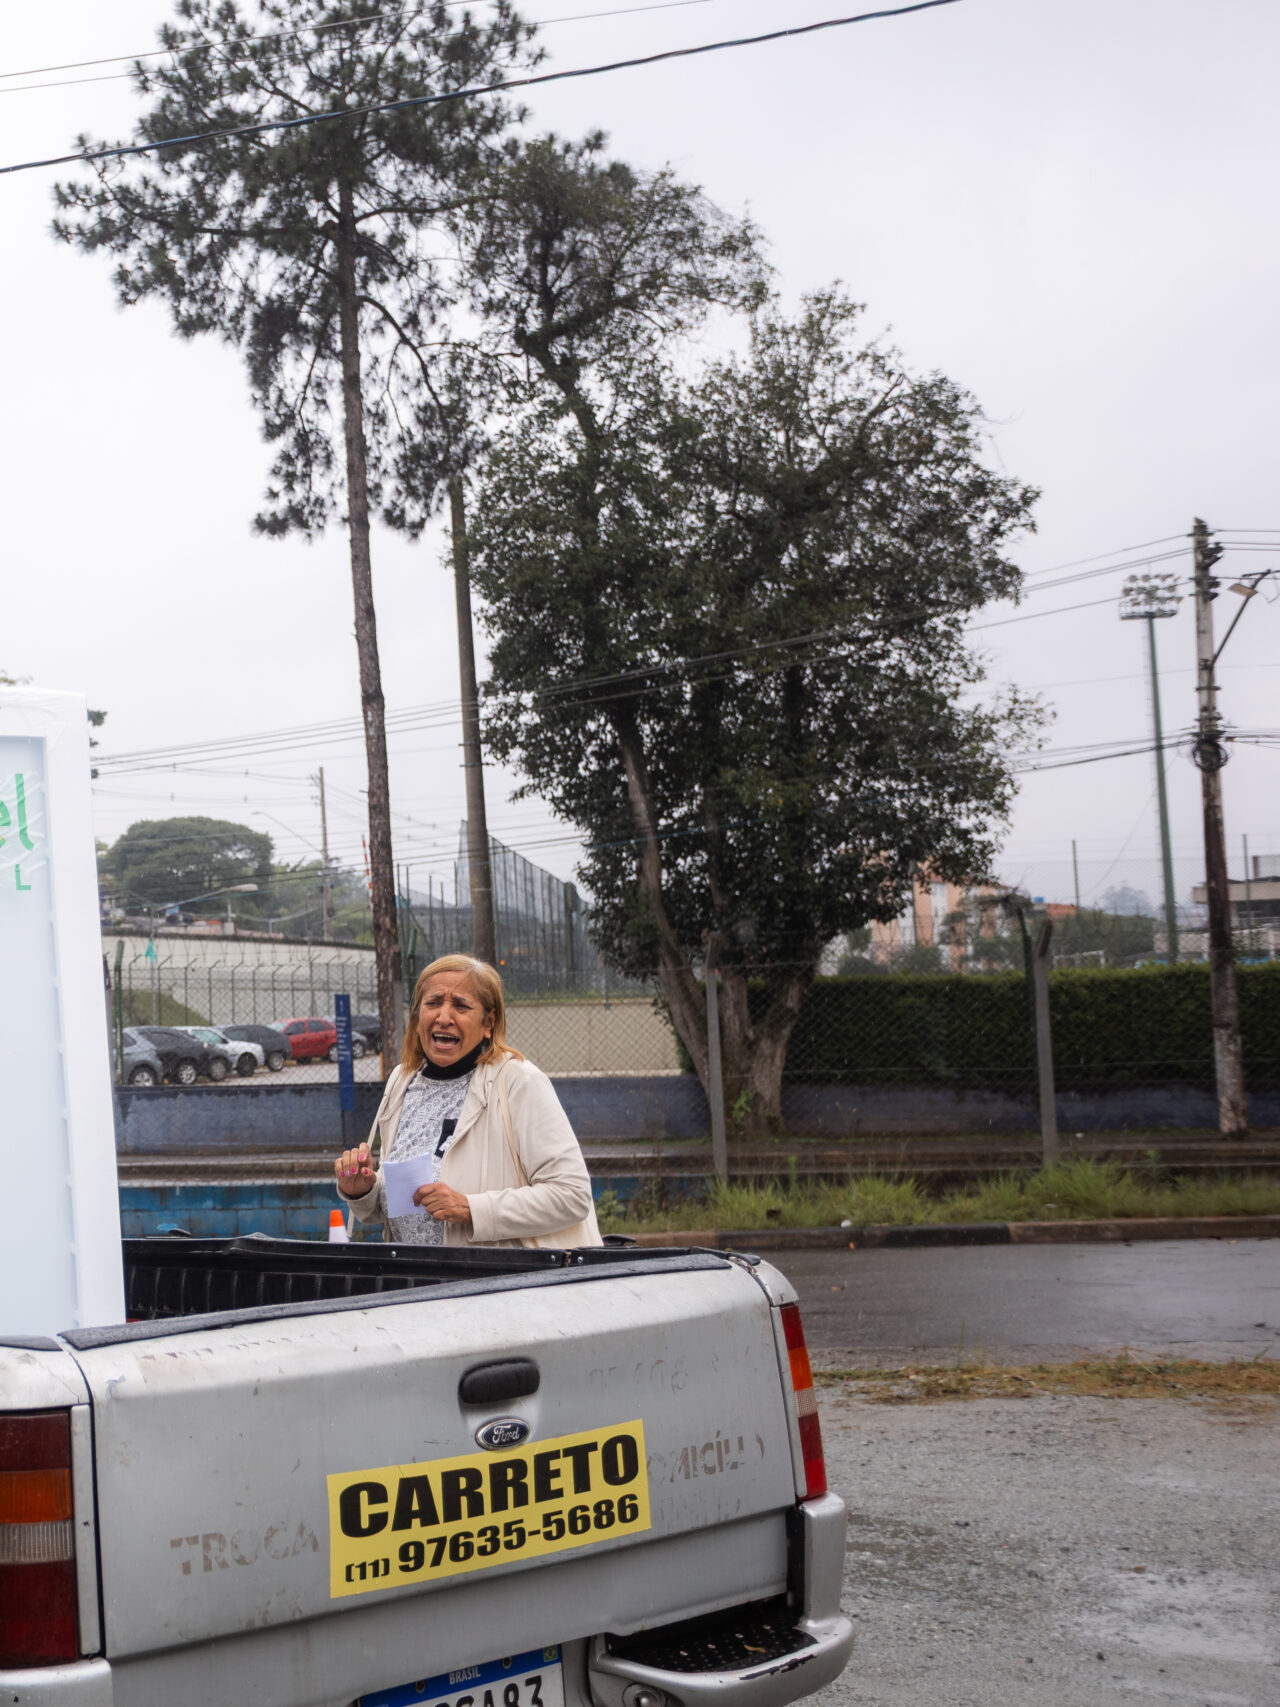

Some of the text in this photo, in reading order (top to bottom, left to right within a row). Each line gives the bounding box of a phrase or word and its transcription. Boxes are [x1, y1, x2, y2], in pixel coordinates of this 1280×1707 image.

[492, 1424, 520, 1444] Ford
[339, 1434, 639, 1538] CARRETO
[345, 1557, 390, 1582] (11)
[398, 1493, 639, 1572] 97635-5686
[449, 1667, 481, 1685] BRASIL
